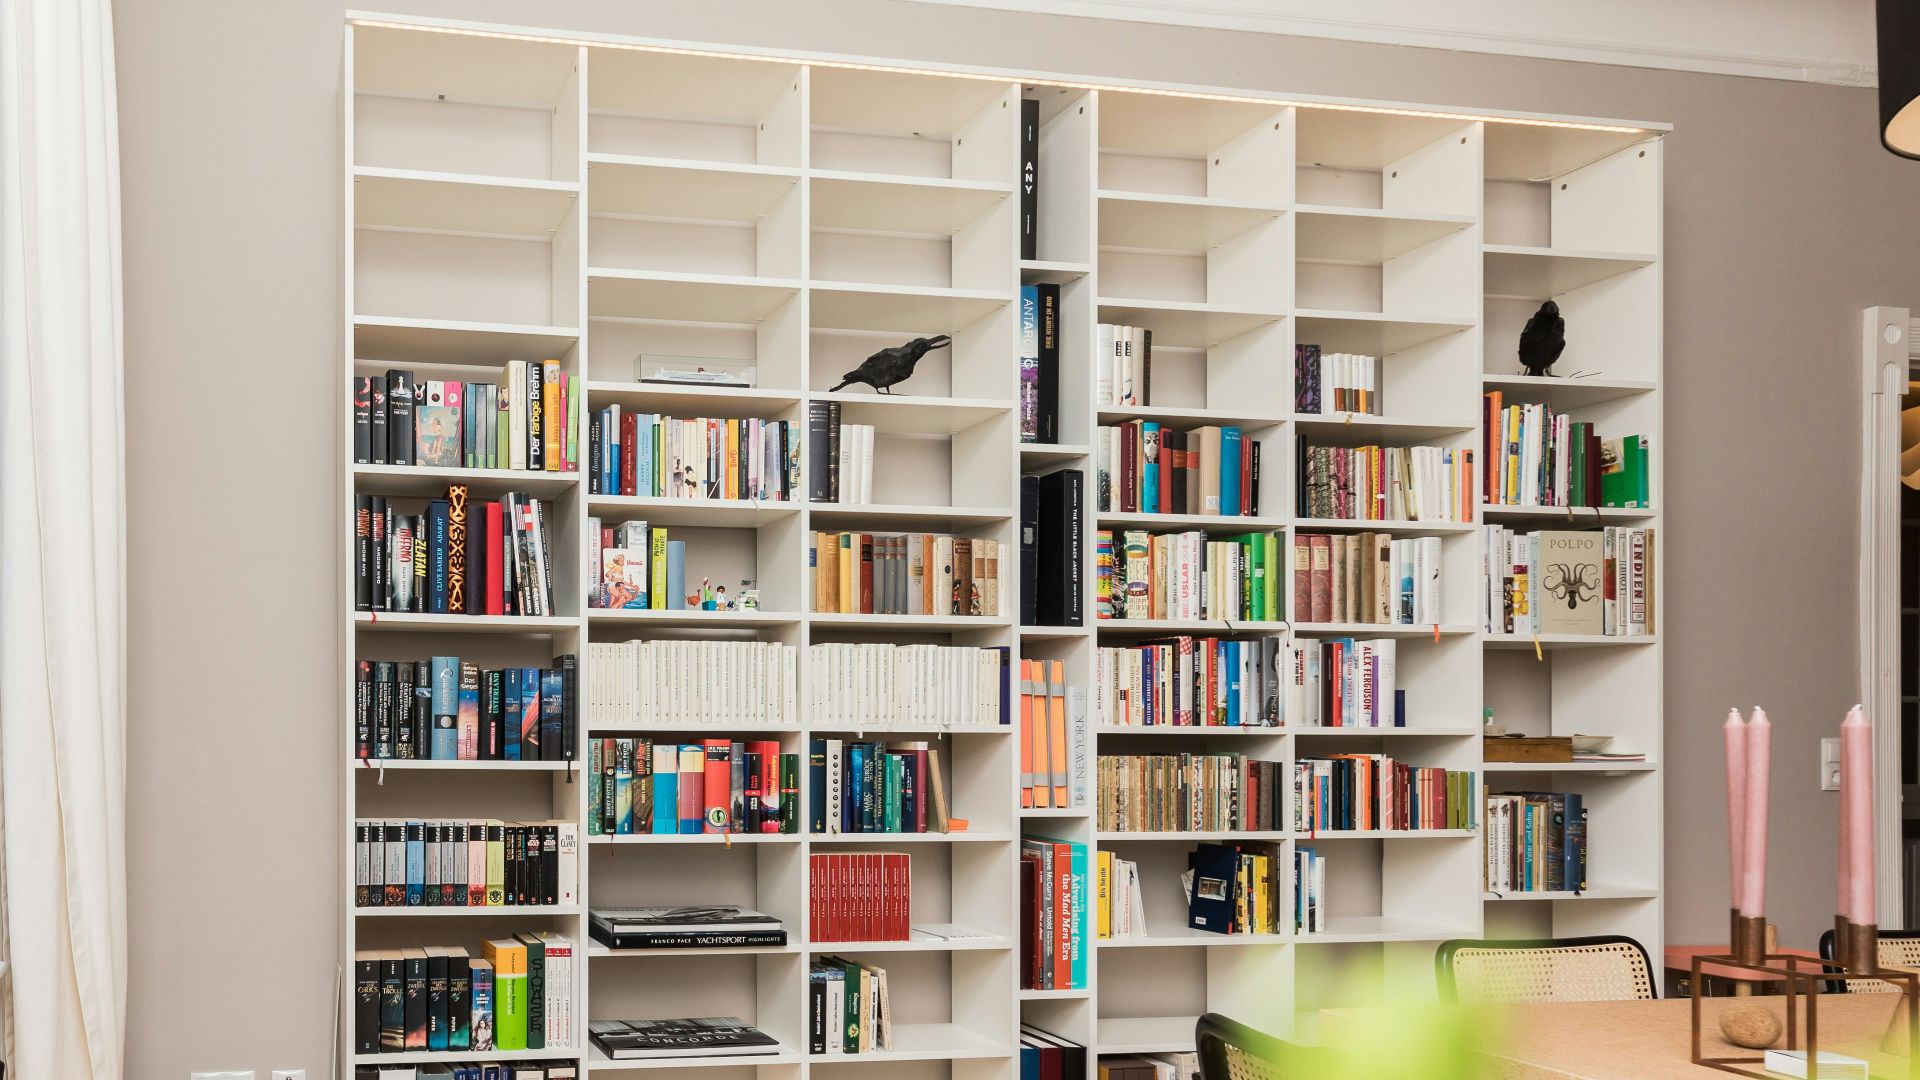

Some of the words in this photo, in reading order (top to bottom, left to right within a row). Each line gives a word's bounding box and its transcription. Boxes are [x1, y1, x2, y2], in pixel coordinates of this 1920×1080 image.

[1024, 162, 1033, 195] ANY
[1045, 307, 1053, 315] IN
[1023, 298, 1034, 369] ANTARCIC
[1045, 316, 1053, 335] NIGHT
[1045, 335, 1053, 349] ONE
[530, 367, 540, 400] Brehm
[530, 400, 542, 435] farbige
[530, 436, 541, 455] Der
[592, 444, 600, 472] Honigtot
[357, 508, 370, 538] SAKRILEG
[399, 528, 412, 563] INFERNO
[1549, 539, 1594, 549] POLPO
[414, 538, 426, 577] ZLATAN
[1619, 566, 1627, 593] BROT
[1633, 542, 1643, 599] INDIEN
[1363, 646, 1372, 666] ALEX
[460, 683, 478, 691] Siegel
[492, 672, 500, 714] UNTERLAND
[1363, 668, 1372, 710] FERGUSON
[1075, 715, 1085, 749] YORK
[636, 742, 645, 760] Potter
[636, 759, 646, 775] Harry
[770, 754, 778, 780] country
[1075, 755, 1085, 779] NEW
[1525, 811, 1533, 829] Sohn
[1525, 830, 1533, 844] und
[1045, 850, 1053, 870] Steve
[1525, 845, 1533, 863] Vater
[1044, 871, 1053, 901] McCurry
[1062, 873, 1070, 890] the
[1062, 891, 1070, 916] Mad
[1071, 873, 1081, 934] Advertising
[1045, 907, 1053, 930] Untold
[1062, 917, 1070, 941] Men
[696, 936, 747, 945] YACHTSPORT
[1062, 942, 1070, 961] Era
[1072, 935, 1081, 961] from
[636, 1034, 742, 1046] CONCORDE
